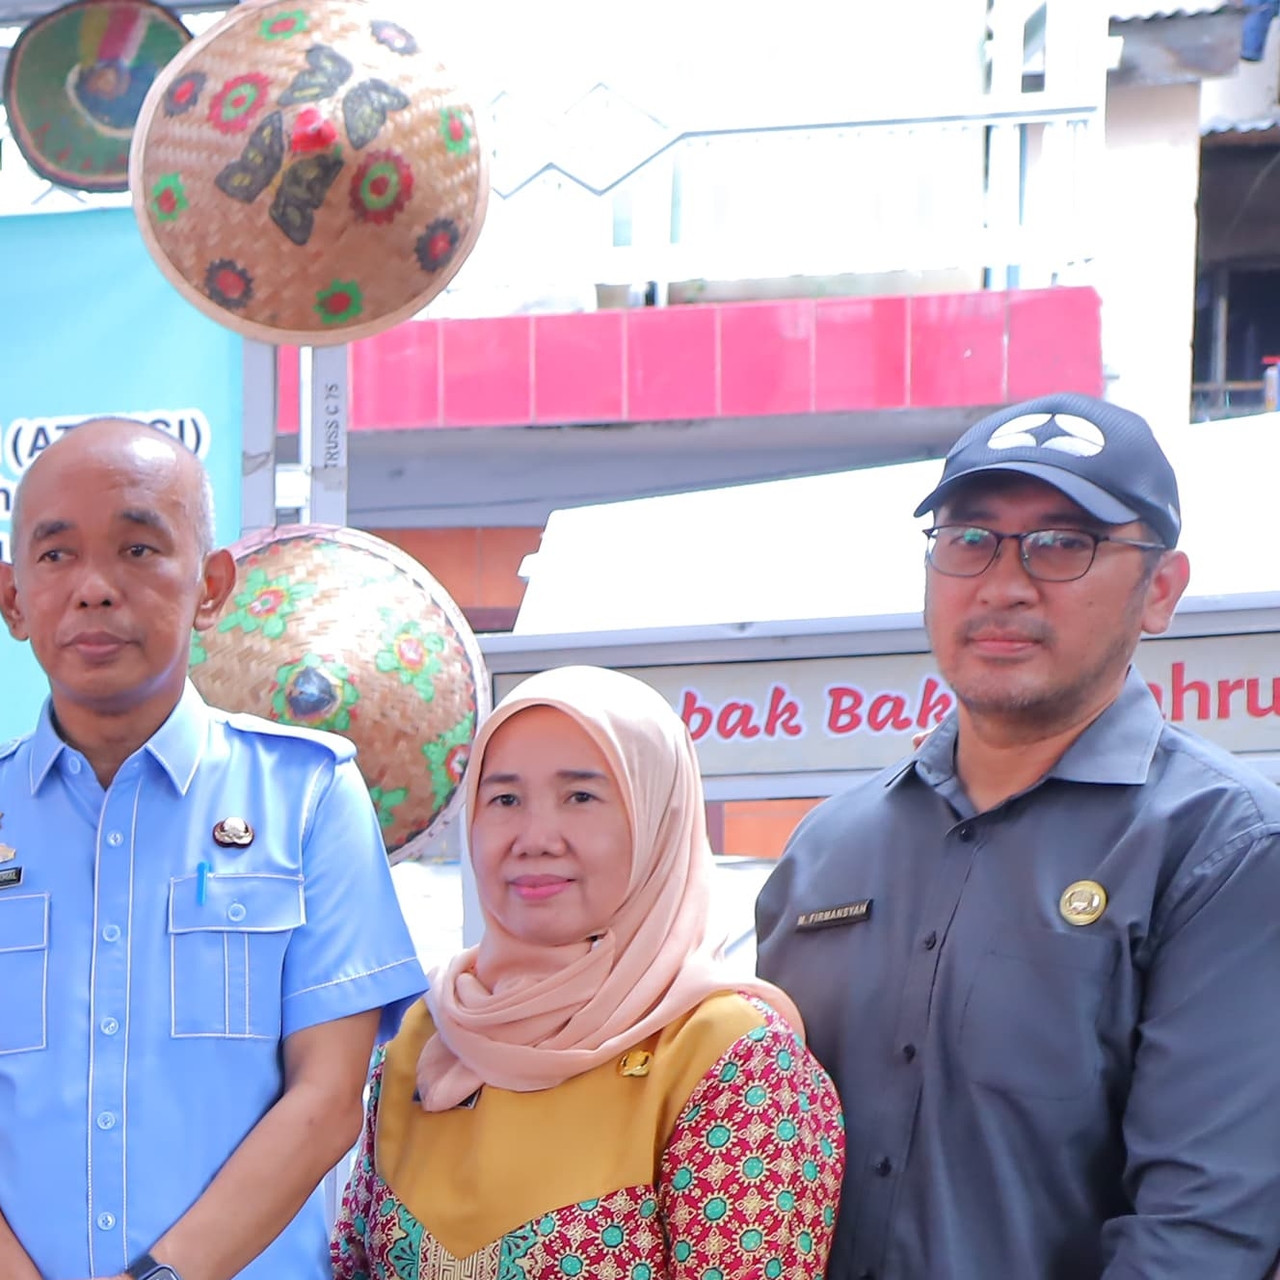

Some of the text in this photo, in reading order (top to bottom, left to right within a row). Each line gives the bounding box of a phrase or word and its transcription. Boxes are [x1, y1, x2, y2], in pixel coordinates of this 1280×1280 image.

[326, 406, 340, 417] C
[324, 419, 340, 470] TRUSS
[809, 903, 868, 924] FIRMANSYAH
